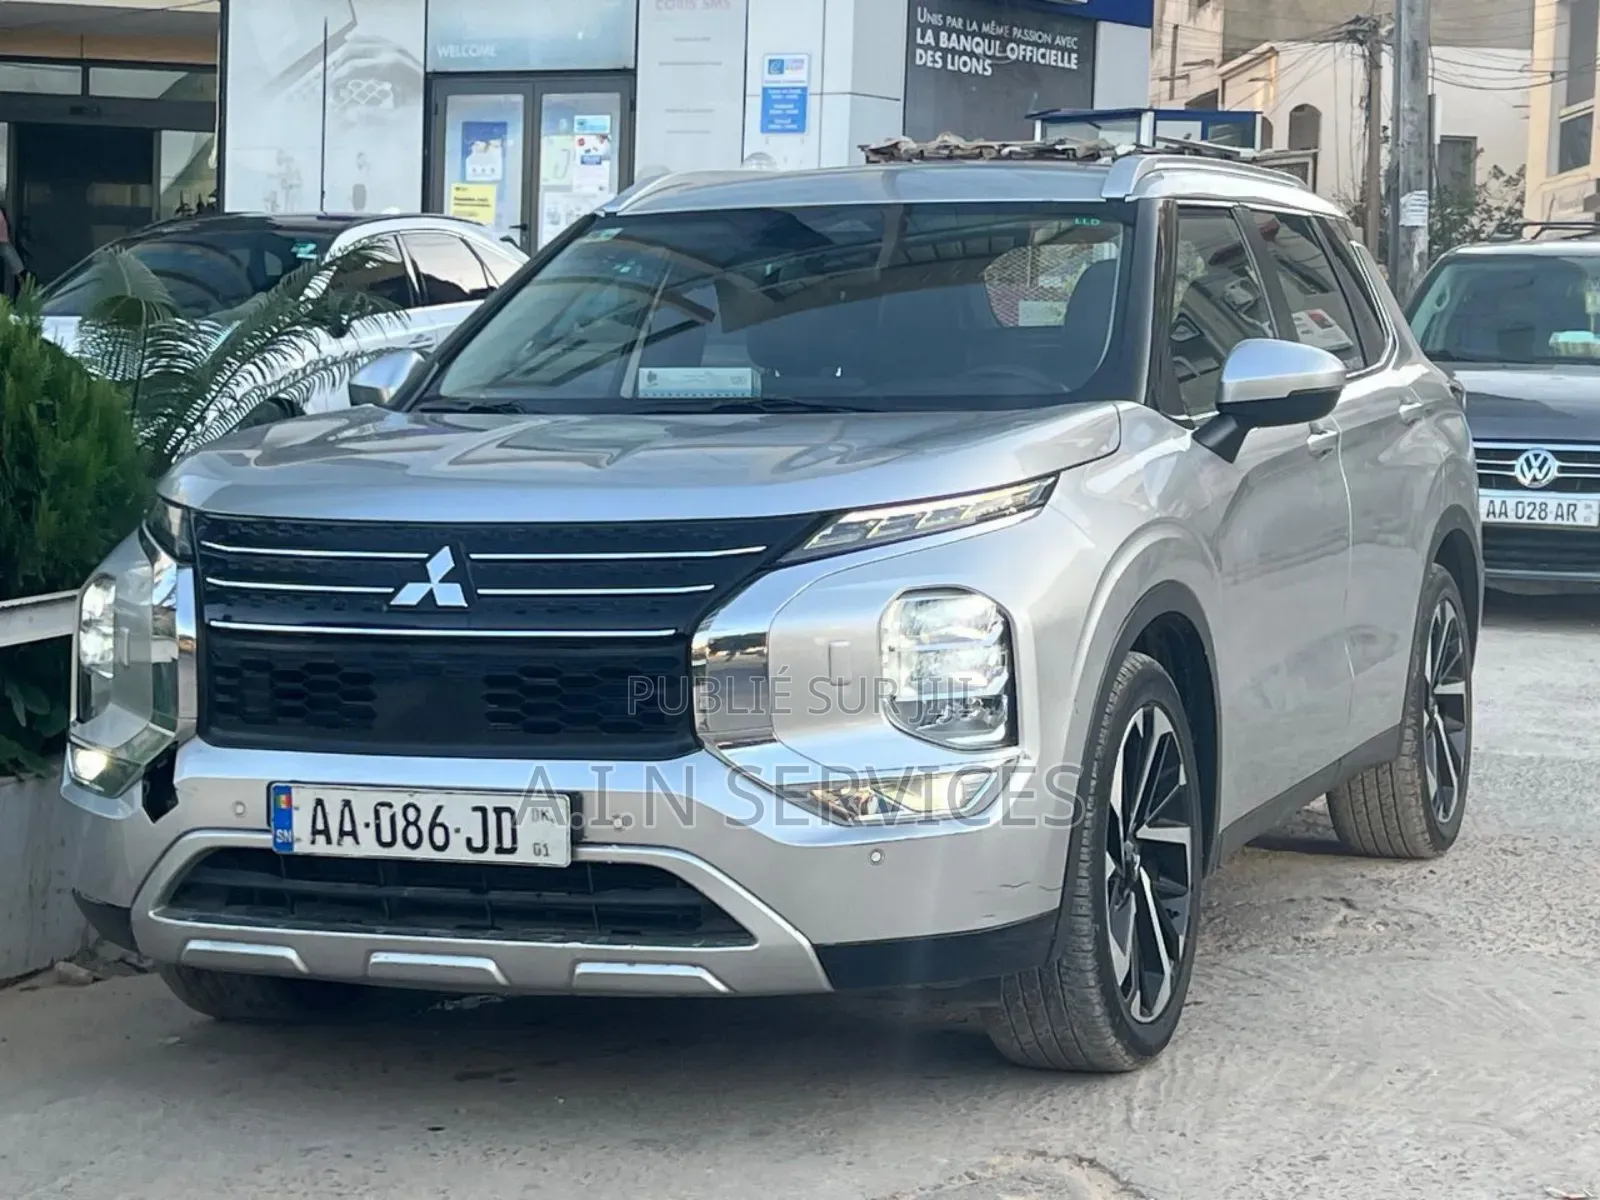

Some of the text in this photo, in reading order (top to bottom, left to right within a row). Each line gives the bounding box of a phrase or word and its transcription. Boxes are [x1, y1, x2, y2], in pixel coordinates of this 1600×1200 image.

[946, 16, 964, 31] PAR
[966, 19, 979, 33] LA
[981, 21, 1010, 38] MÊME
[1012, 27, 1051, 44] PASSION
[1054, 34, 1079, 49] AVEC
[436, 44, 498, 58] WELCOME
[915, 49, 993, 76] DES LIONS
[916, 28, 935, 46] LA
[1006, 42, 1079, 70] OFFICIELLE
[276, 828, 292, 843] SN
